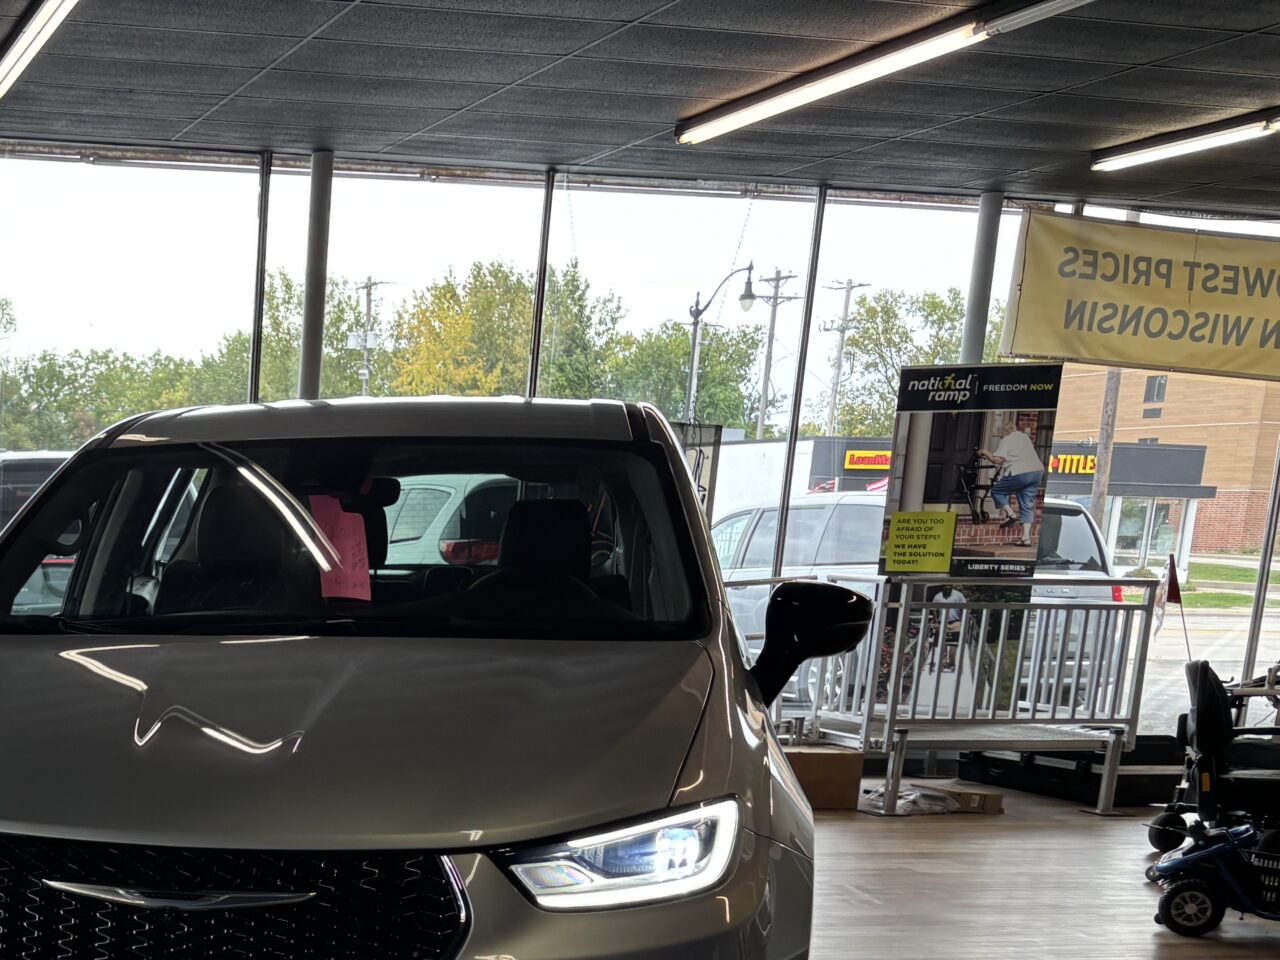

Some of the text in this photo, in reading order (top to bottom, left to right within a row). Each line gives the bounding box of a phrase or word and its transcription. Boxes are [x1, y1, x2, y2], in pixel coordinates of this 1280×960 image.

[908, 373, 972, 391] national
[983, 383, 1053, 392] FREEDOM NOW
[928, 390, 970, 404] ramp
